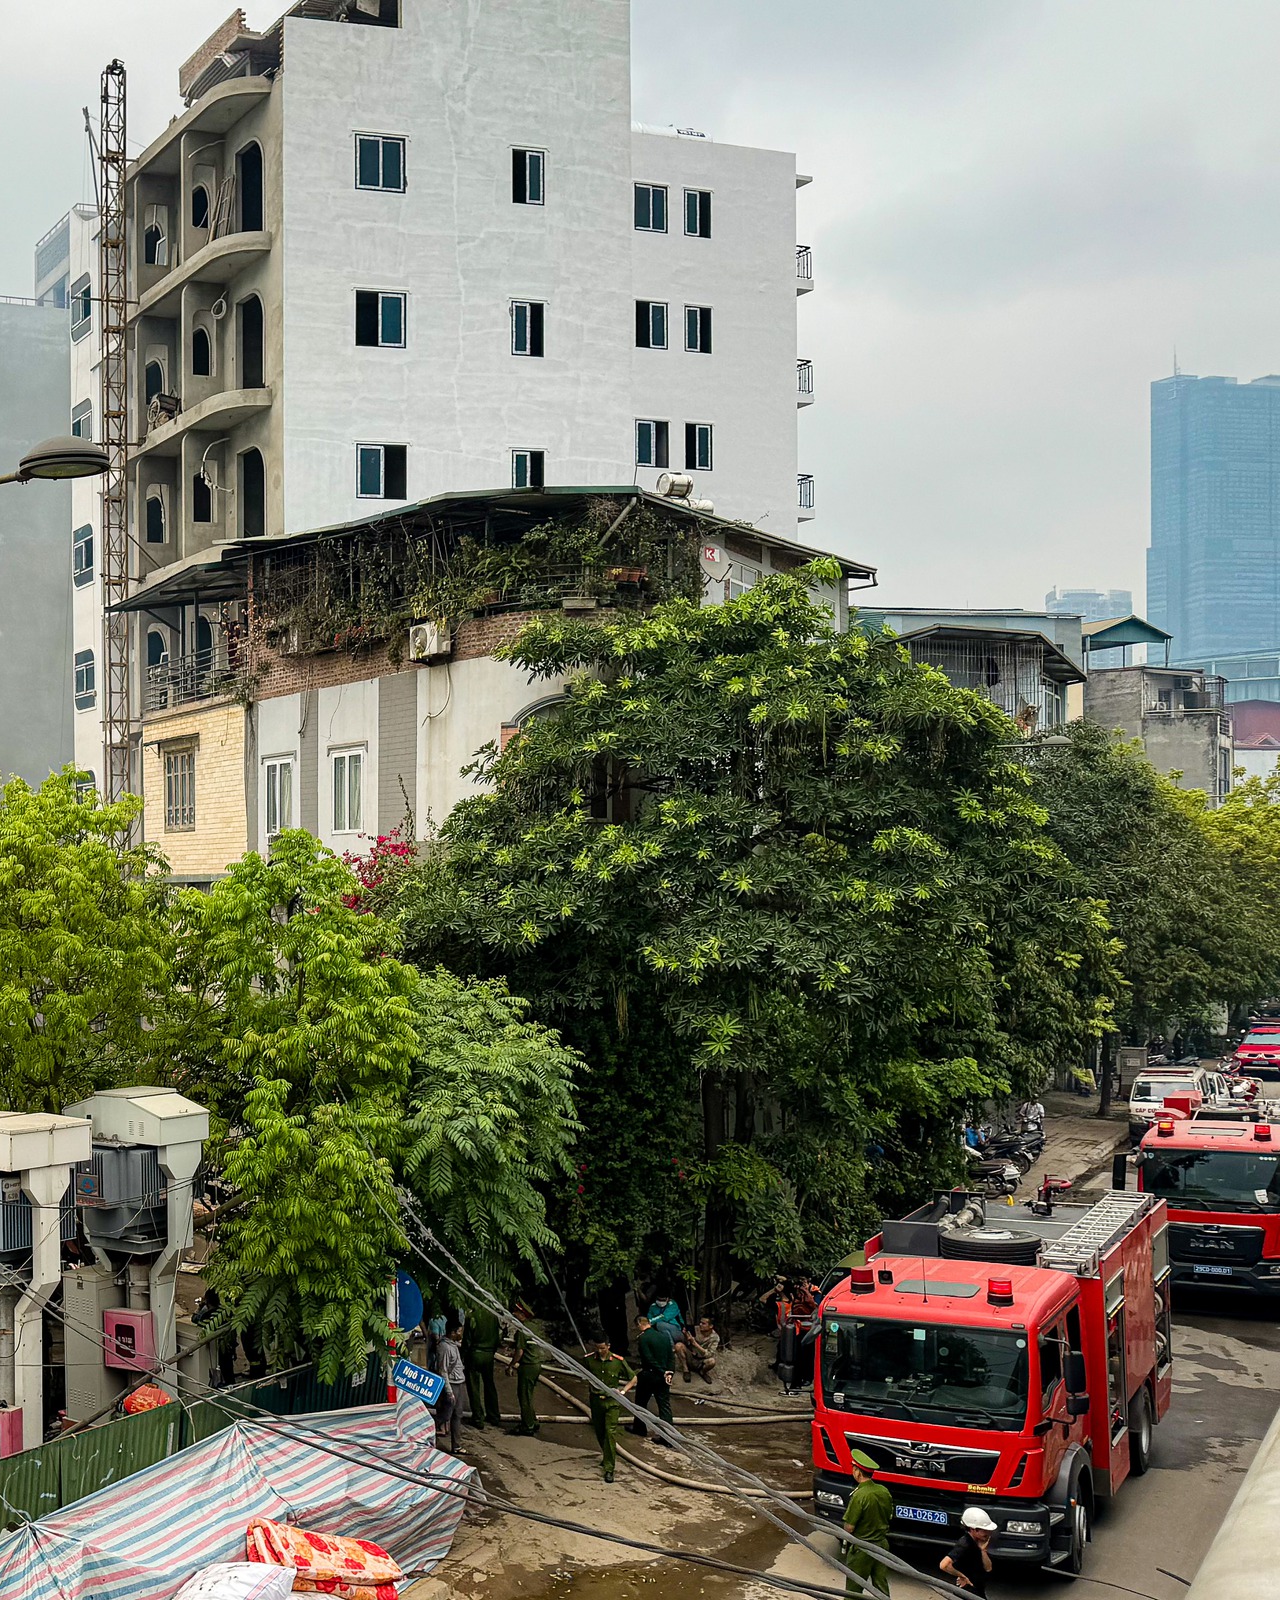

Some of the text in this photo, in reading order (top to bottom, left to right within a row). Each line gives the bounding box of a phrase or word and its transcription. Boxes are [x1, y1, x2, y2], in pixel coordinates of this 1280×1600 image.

[1190, 1238, 1235, 1250] MAN
[402, 1366, 435, 1387] Ngõ 116
[896, 1457, 946, 1473] MAN
[898, 1507, 946, 1523] 29A-026.26
